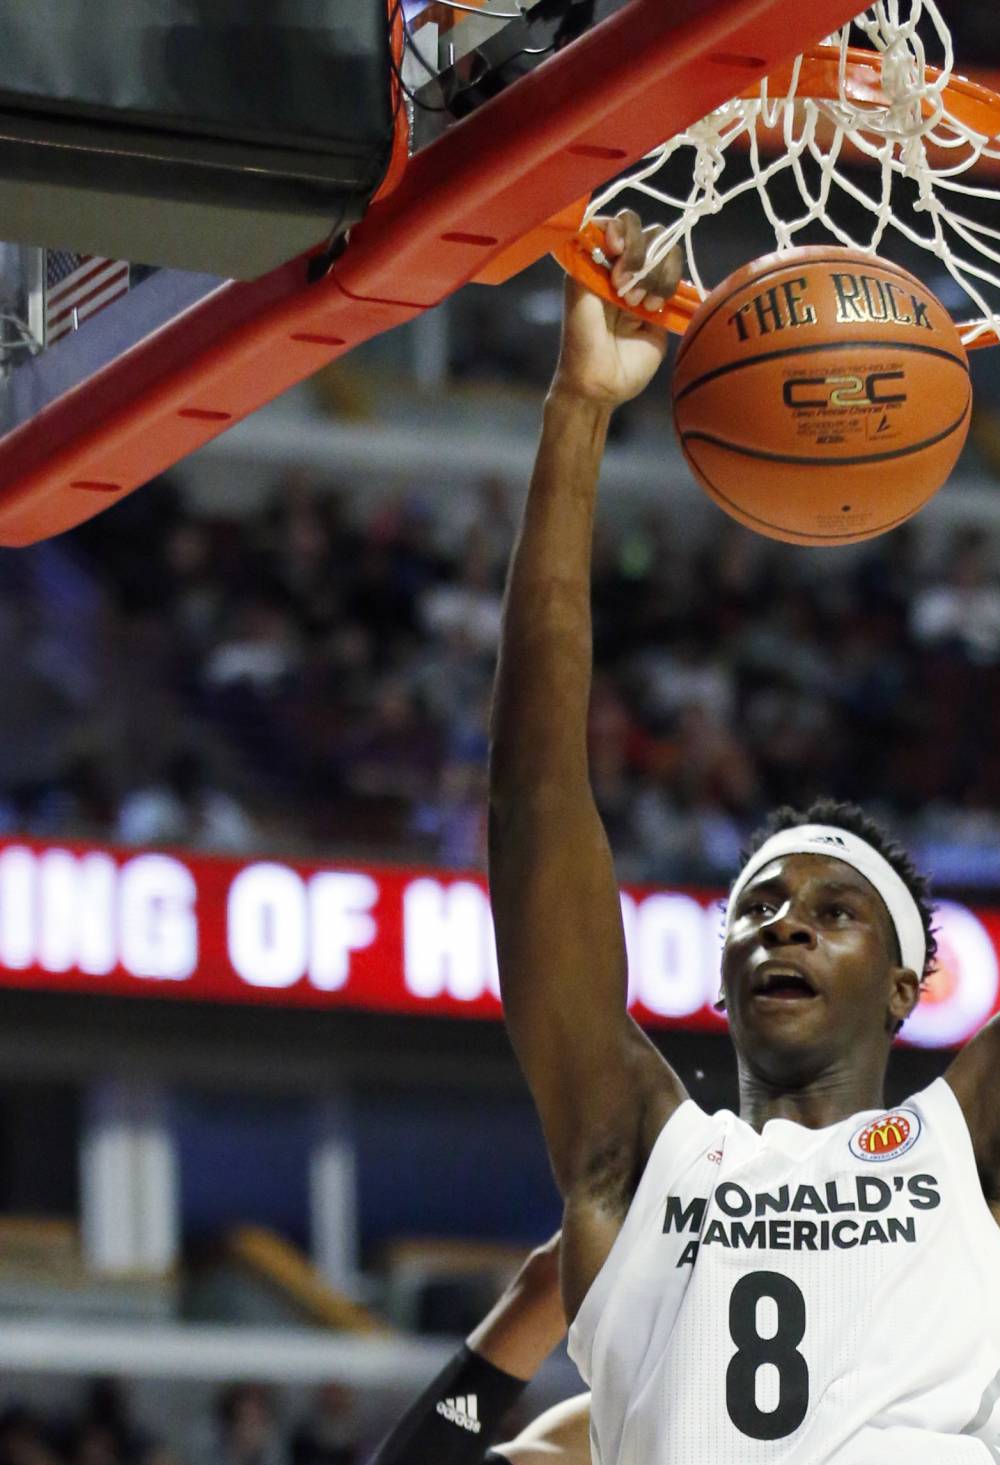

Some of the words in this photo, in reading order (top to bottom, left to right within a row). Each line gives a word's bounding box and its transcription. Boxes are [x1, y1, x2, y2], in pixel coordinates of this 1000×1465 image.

[728, 277, 816, 342] THE
[829, 272, 934, 331] ROCK
[783, 370, 907, 409] C2C
[227, 861, 377, 991] OF
[702, 1217, 916, 1250] AMERICAN
[726, 1270, 809, 1441] 8
[436, 1401, 481, 1433] adidas
